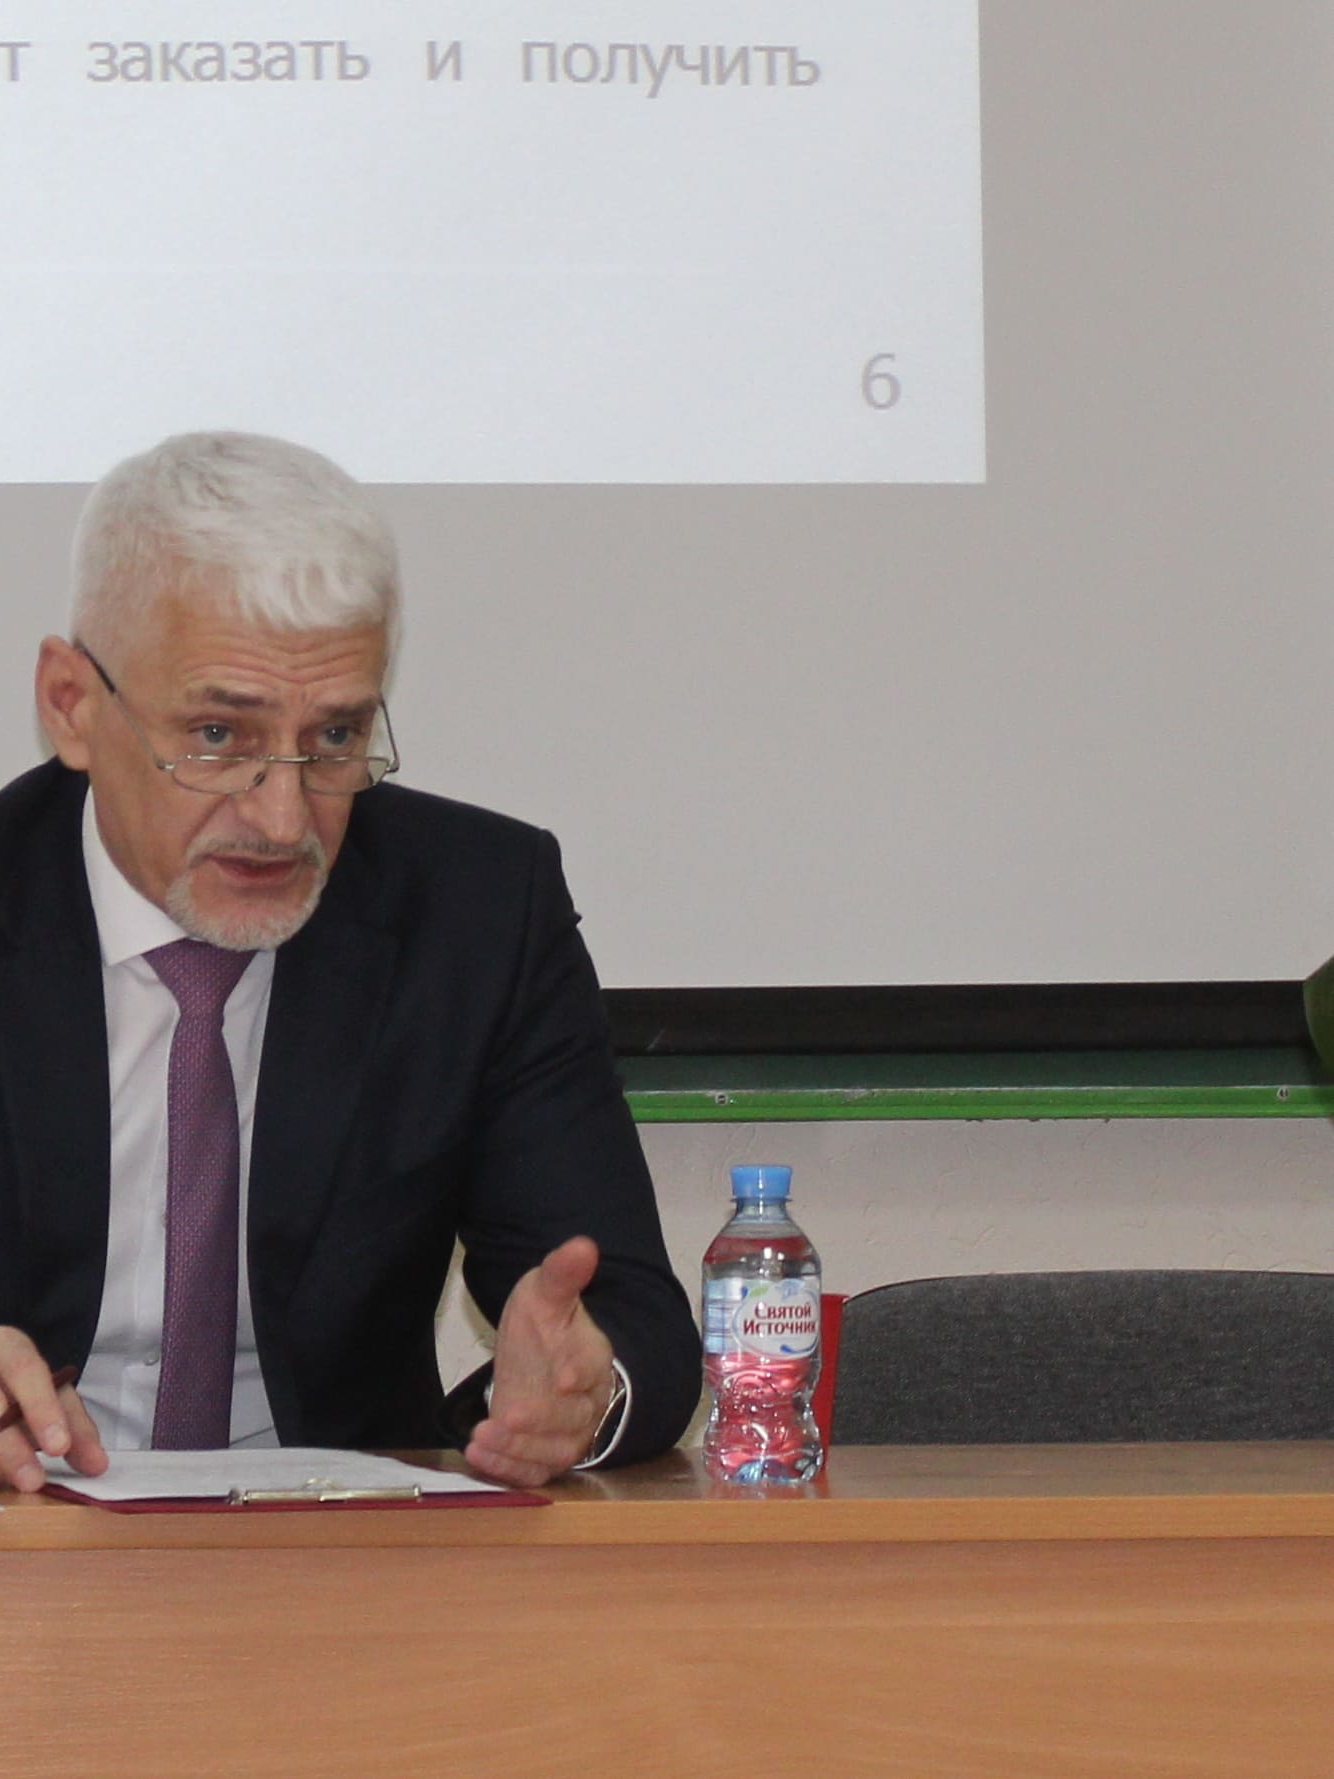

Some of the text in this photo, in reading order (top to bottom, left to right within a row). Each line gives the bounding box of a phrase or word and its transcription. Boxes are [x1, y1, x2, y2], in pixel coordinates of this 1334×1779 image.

[86, 39, 371, 83] заказать
[426, 40, 463, 82] и
[521, 41, 822, 98] получить
[861, 352, 902, 411] 6
[754, 1301, 811, 1319] Святой
